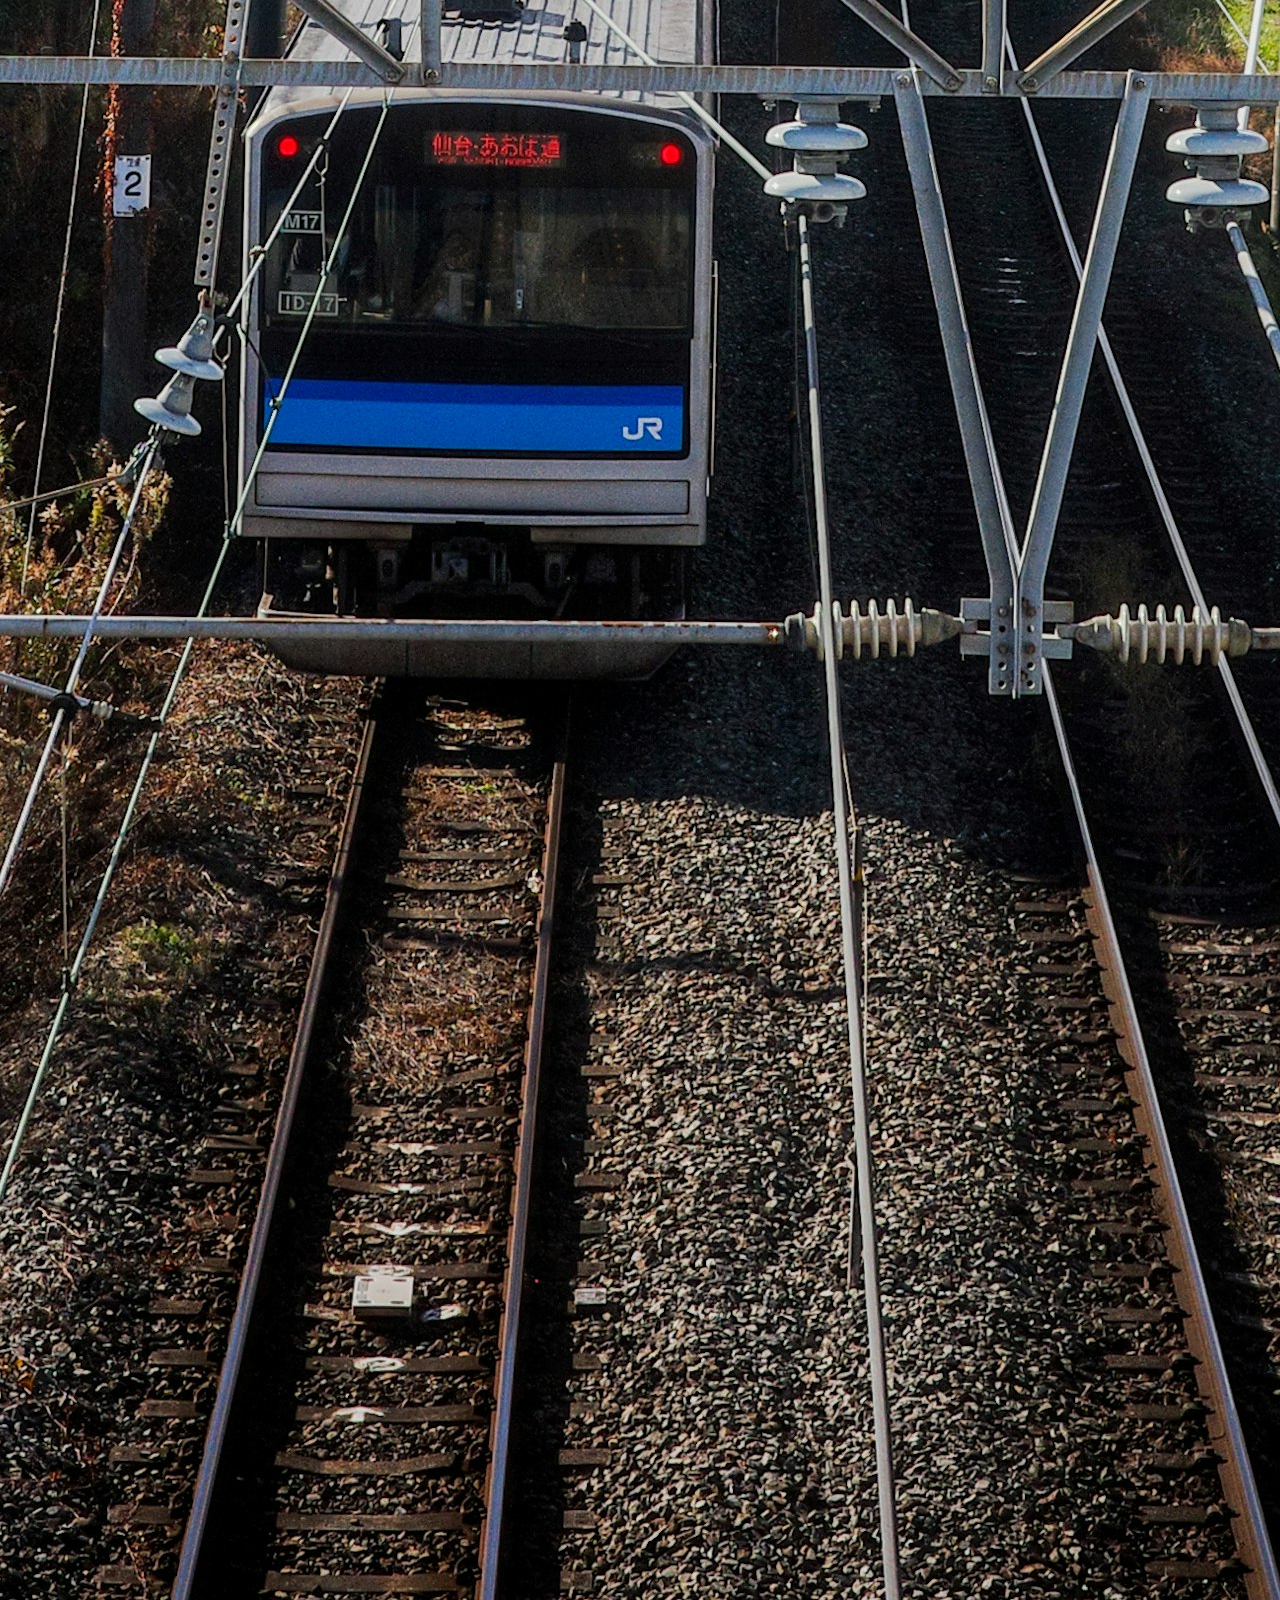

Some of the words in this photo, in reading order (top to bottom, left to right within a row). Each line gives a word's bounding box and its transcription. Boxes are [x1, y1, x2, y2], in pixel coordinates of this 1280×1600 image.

[124, 170, 142, 197] 2
[284, 214, 320, 230] M17
[622, 417, 663, 441] JR
